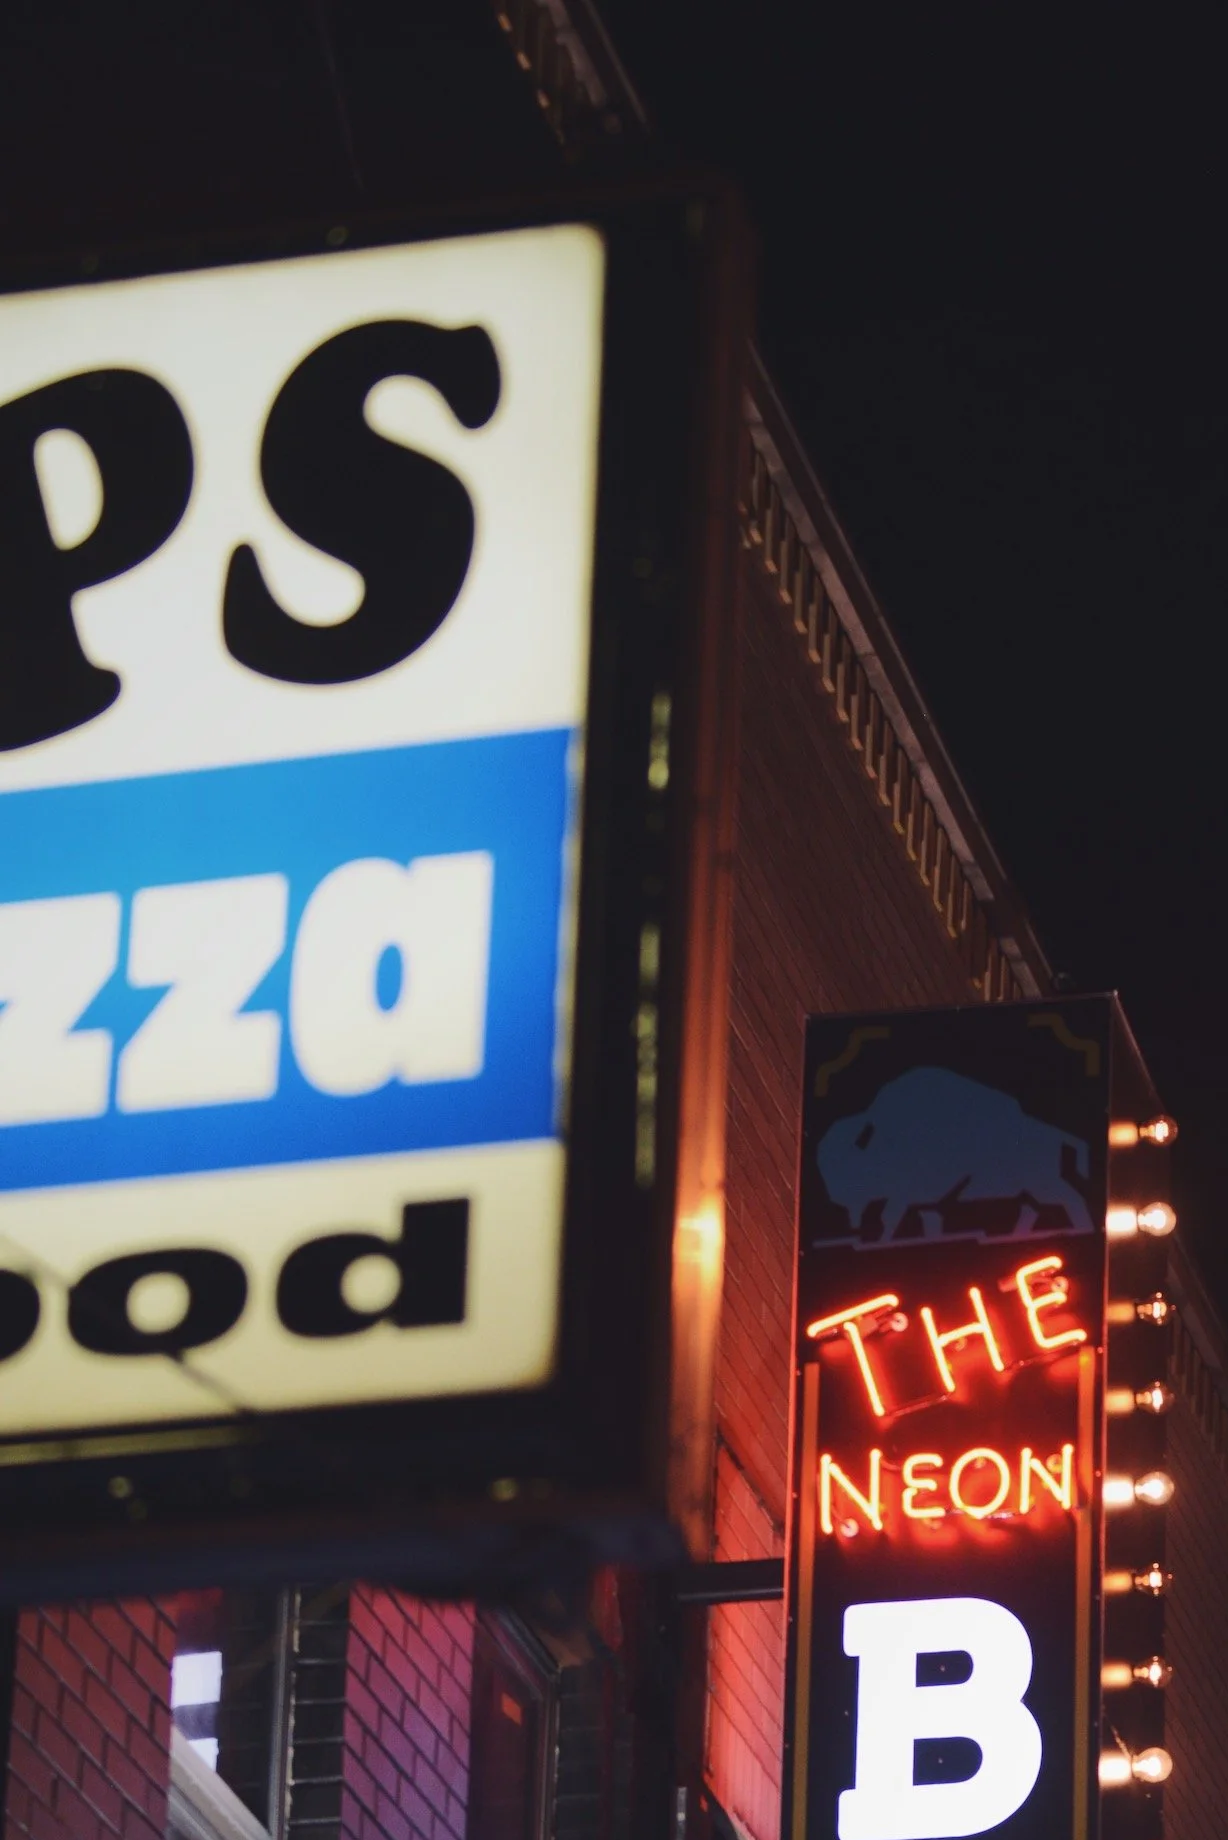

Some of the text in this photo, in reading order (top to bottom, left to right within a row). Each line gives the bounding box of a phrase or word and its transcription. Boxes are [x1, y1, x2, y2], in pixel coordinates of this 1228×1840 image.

[0, 1197, 471, 1363] od
[806, 1255, 1087, 1417] THE
[819, 1442, 1075, 1534] NEON
